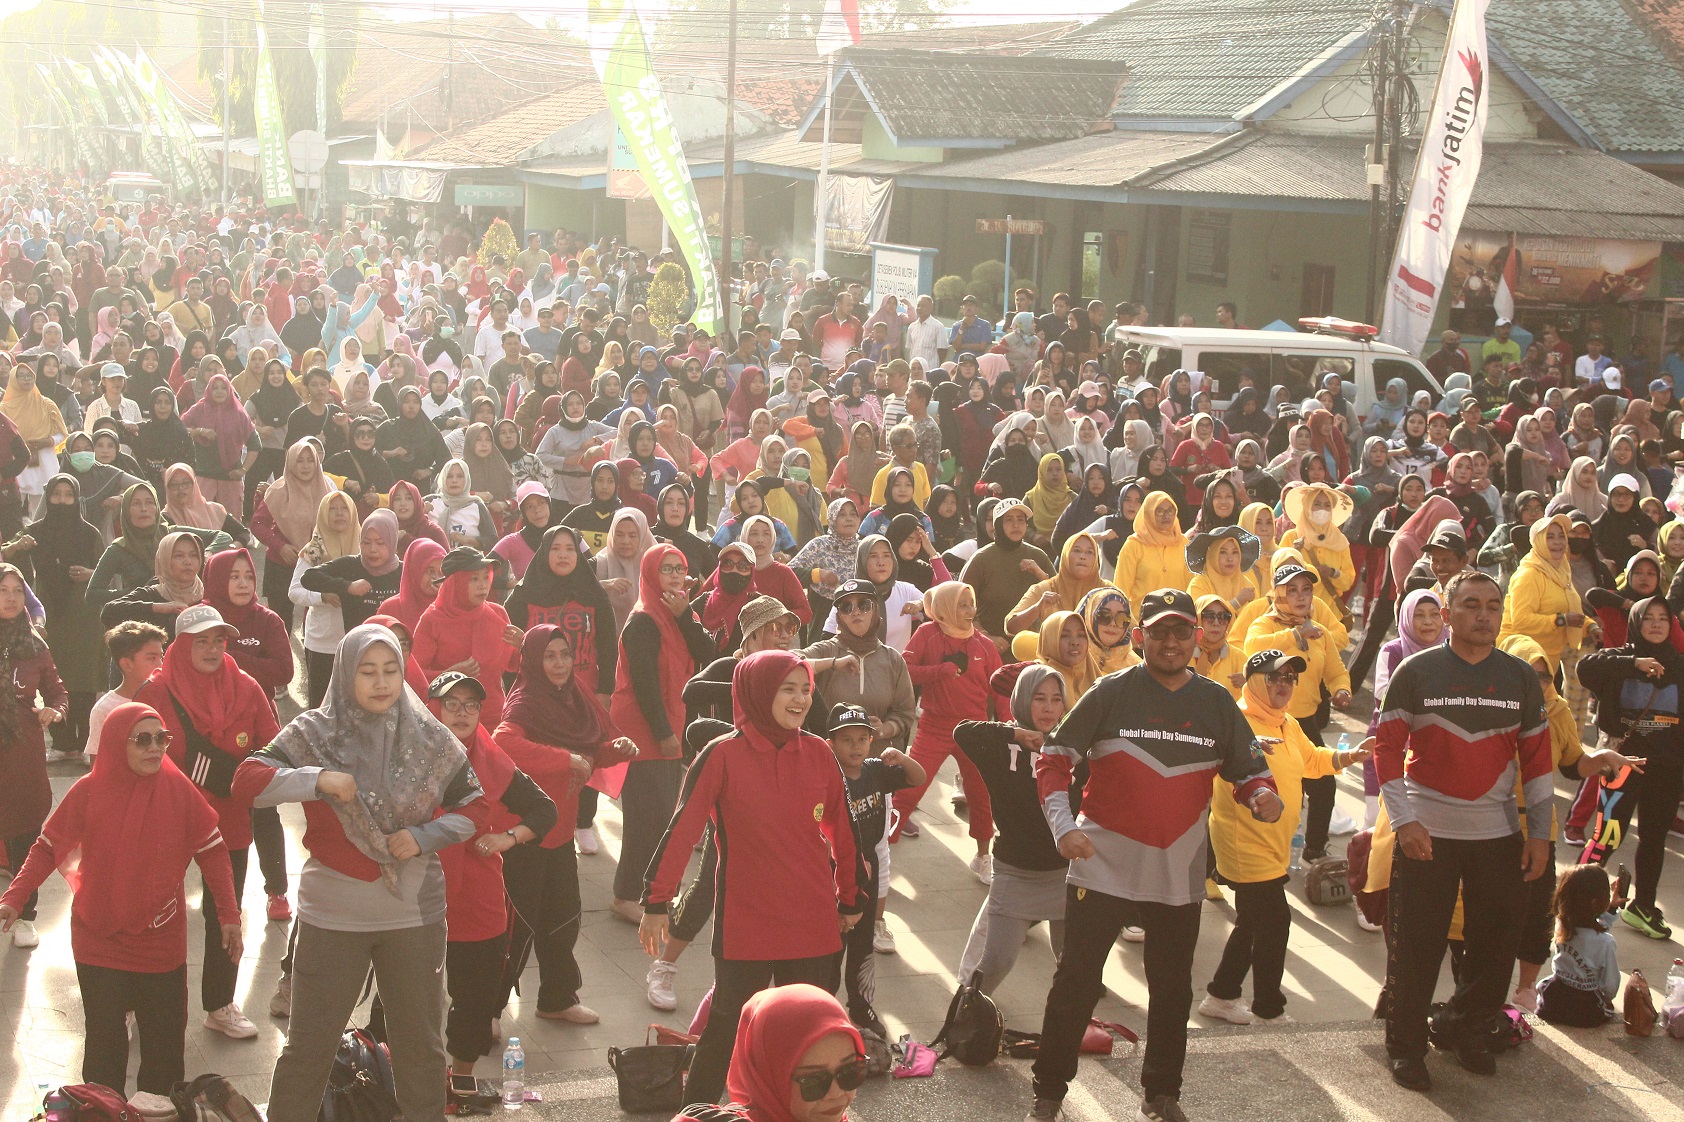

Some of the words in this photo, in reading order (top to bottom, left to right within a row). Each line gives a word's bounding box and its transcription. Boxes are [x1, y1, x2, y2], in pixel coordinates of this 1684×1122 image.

[593, 533, 603, 548] 5
[1423, 698, 1444, 707] Global
[1444, 696, 1465, 707] Family
[1466, 696, 1477, 706] Day
[1477, 697, 1506, 709] Sumenep
[1507, 699, 1520, 710] 2024
[839, 709, 853, 722] FREE
[1119, 728, 1140, 738] Global
[1141, 729, 1161, 740] Family
[1162, 730, 1174, 741] Day
[1175, 731, 1203, 745] Sumenep
